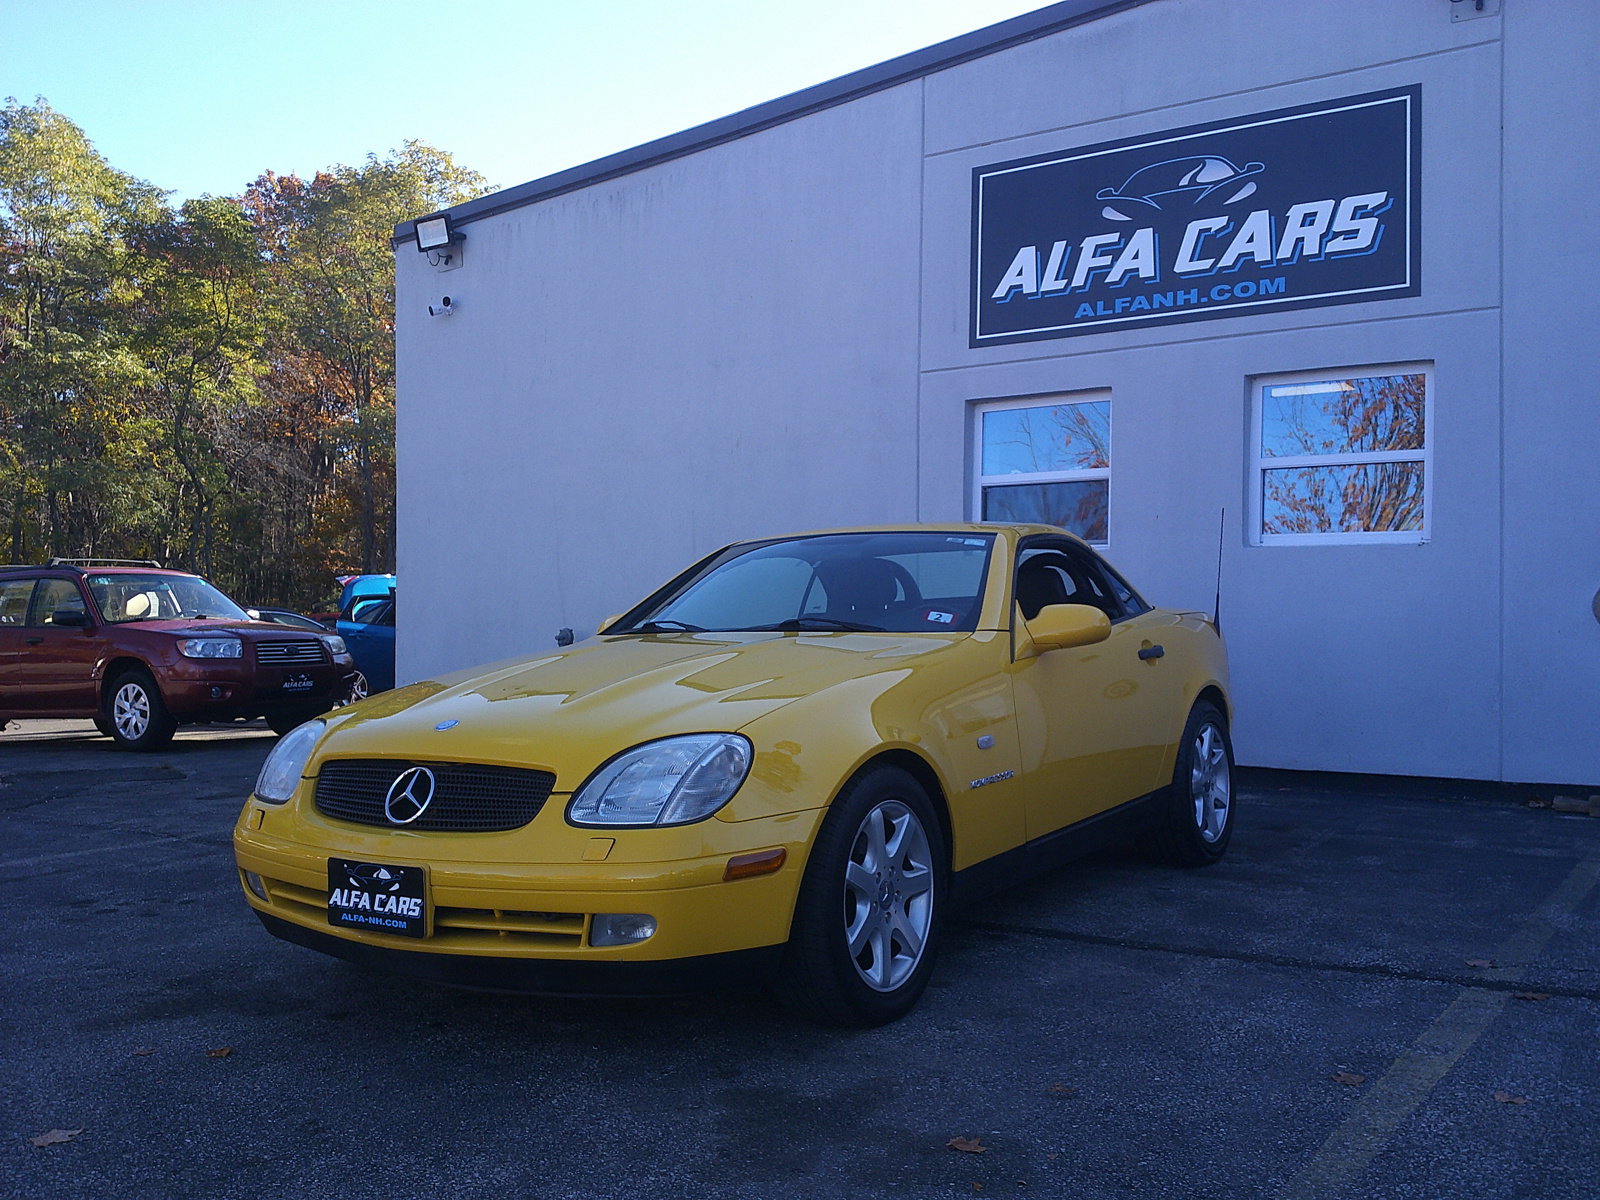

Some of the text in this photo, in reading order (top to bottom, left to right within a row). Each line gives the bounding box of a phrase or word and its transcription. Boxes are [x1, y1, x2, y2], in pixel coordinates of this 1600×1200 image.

[991, 191, 1391, 302] ALFA CARS
[1074, 276, 1286, 319] ALFANH.COM
[329, 888, 423, 918] ALFA CARS
[341, 913, 407, 929] ALFA-NH.COM
